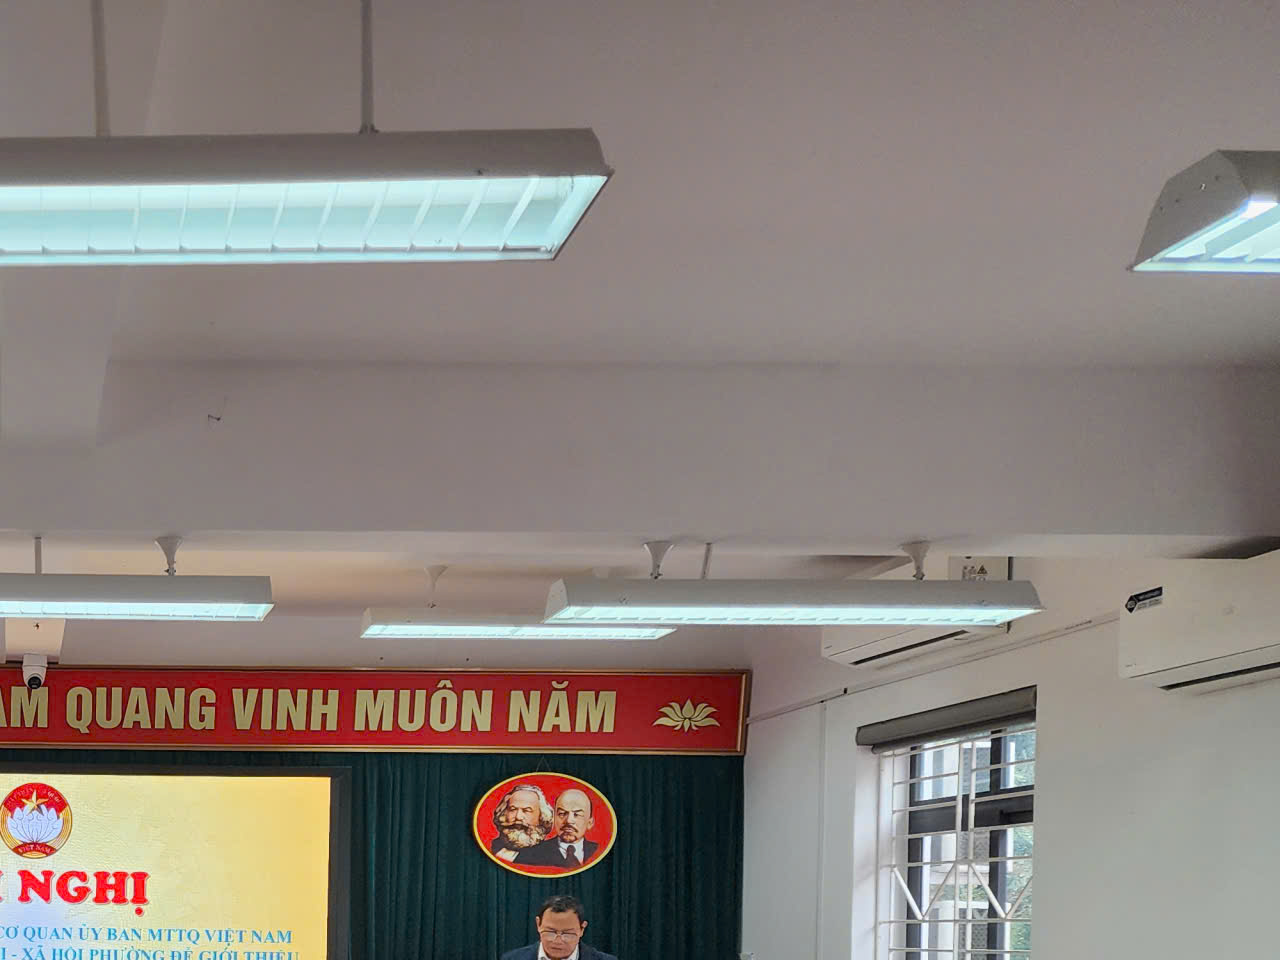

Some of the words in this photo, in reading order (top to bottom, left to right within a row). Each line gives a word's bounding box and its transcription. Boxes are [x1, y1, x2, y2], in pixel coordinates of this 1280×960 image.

[65, 686, 217, 732] QUANG
[232, 688, 338, 731] VINH
[354, 680, 494, 733] MUÔN
[508, 680, 617, 734] NĂM
[17, 869, 150, 916] NGHỊ
[23, 926, 73, 942] QUAN
[79, 923, 102, 940] ỦY
[107, 927, 142, 941] BAN
[147, 928, 199, 945] MTTQ
[204, 928, 247, 946] VIỆT
[251, 930, 292, 944] NAM
[22, 945, 46, 960] XÃ
